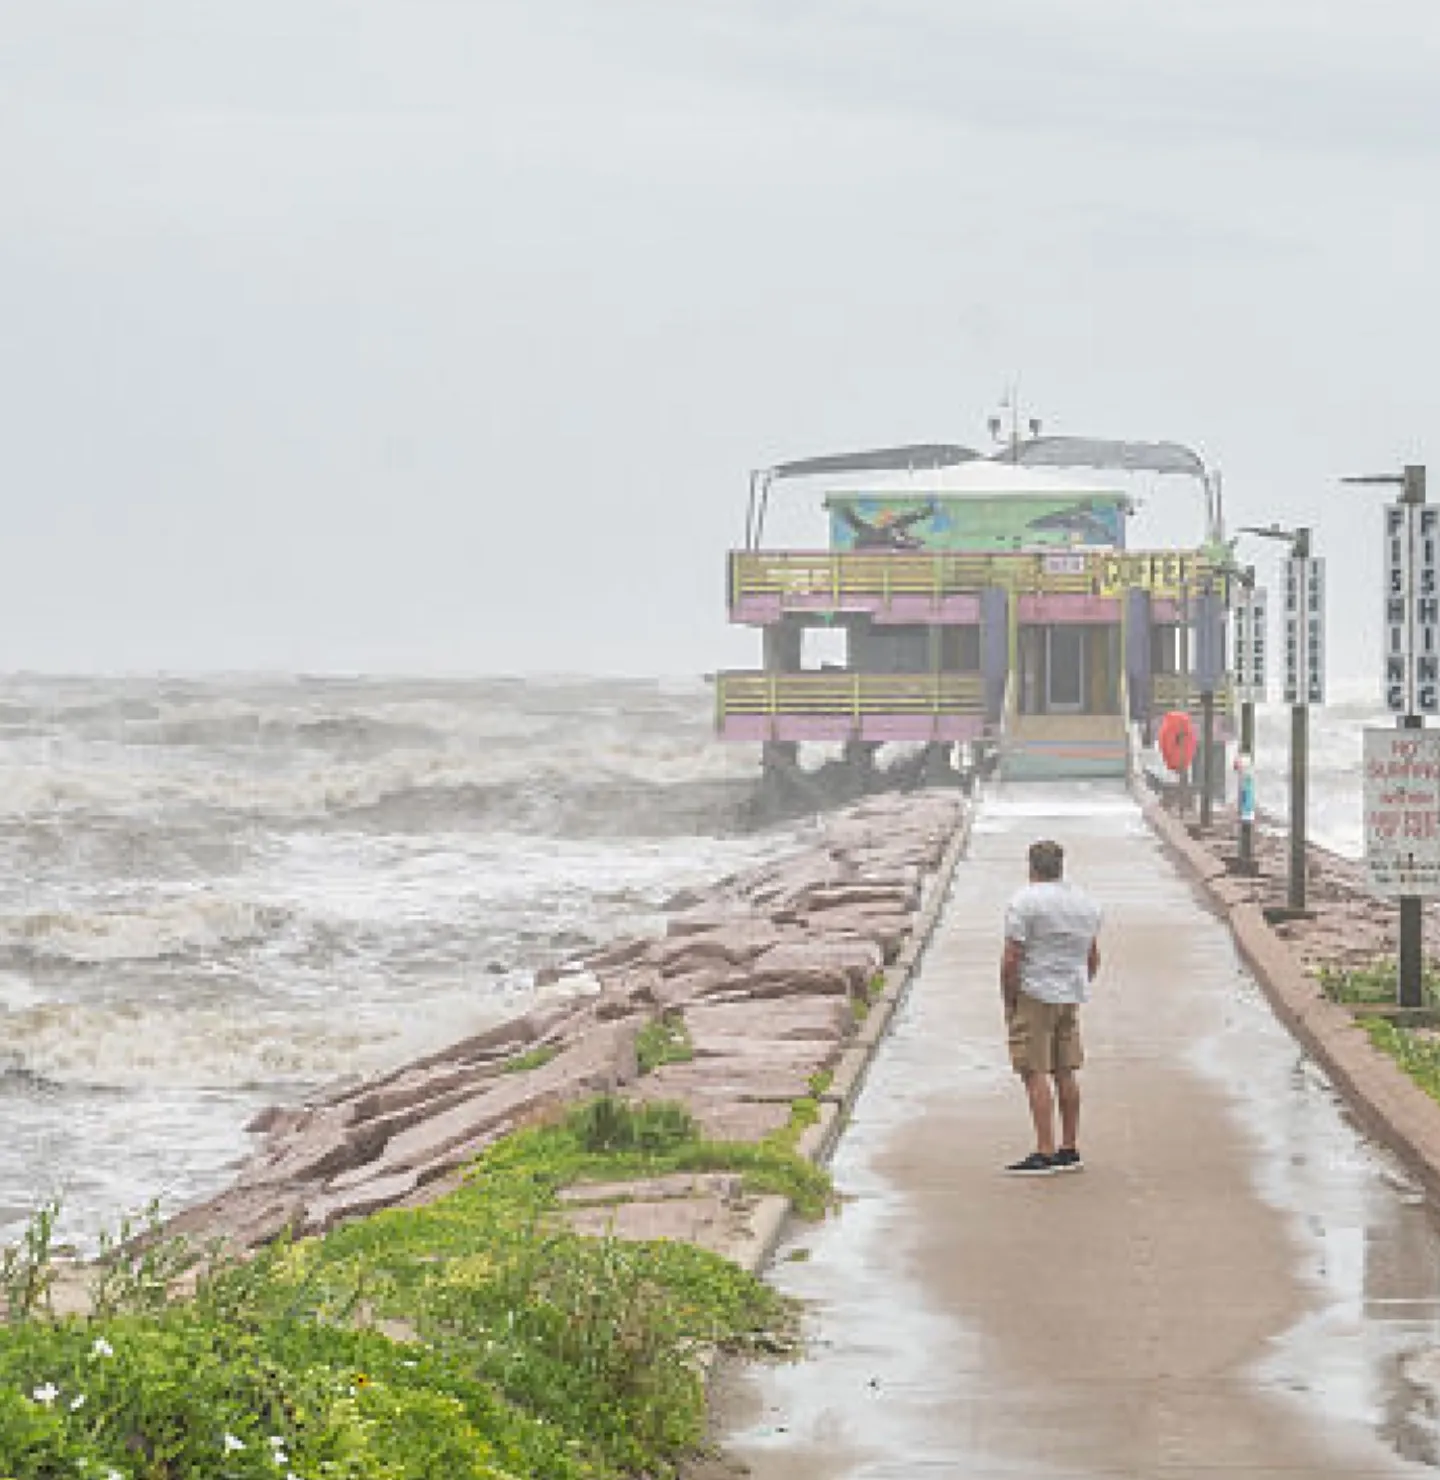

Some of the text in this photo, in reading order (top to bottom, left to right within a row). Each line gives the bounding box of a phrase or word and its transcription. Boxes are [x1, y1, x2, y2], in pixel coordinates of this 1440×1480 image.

[1097, 555, 1190, 589] COFFEE
[1387, 510, 1405, 712] FISHING
[1416, 510, 1439, 712] FISHING
